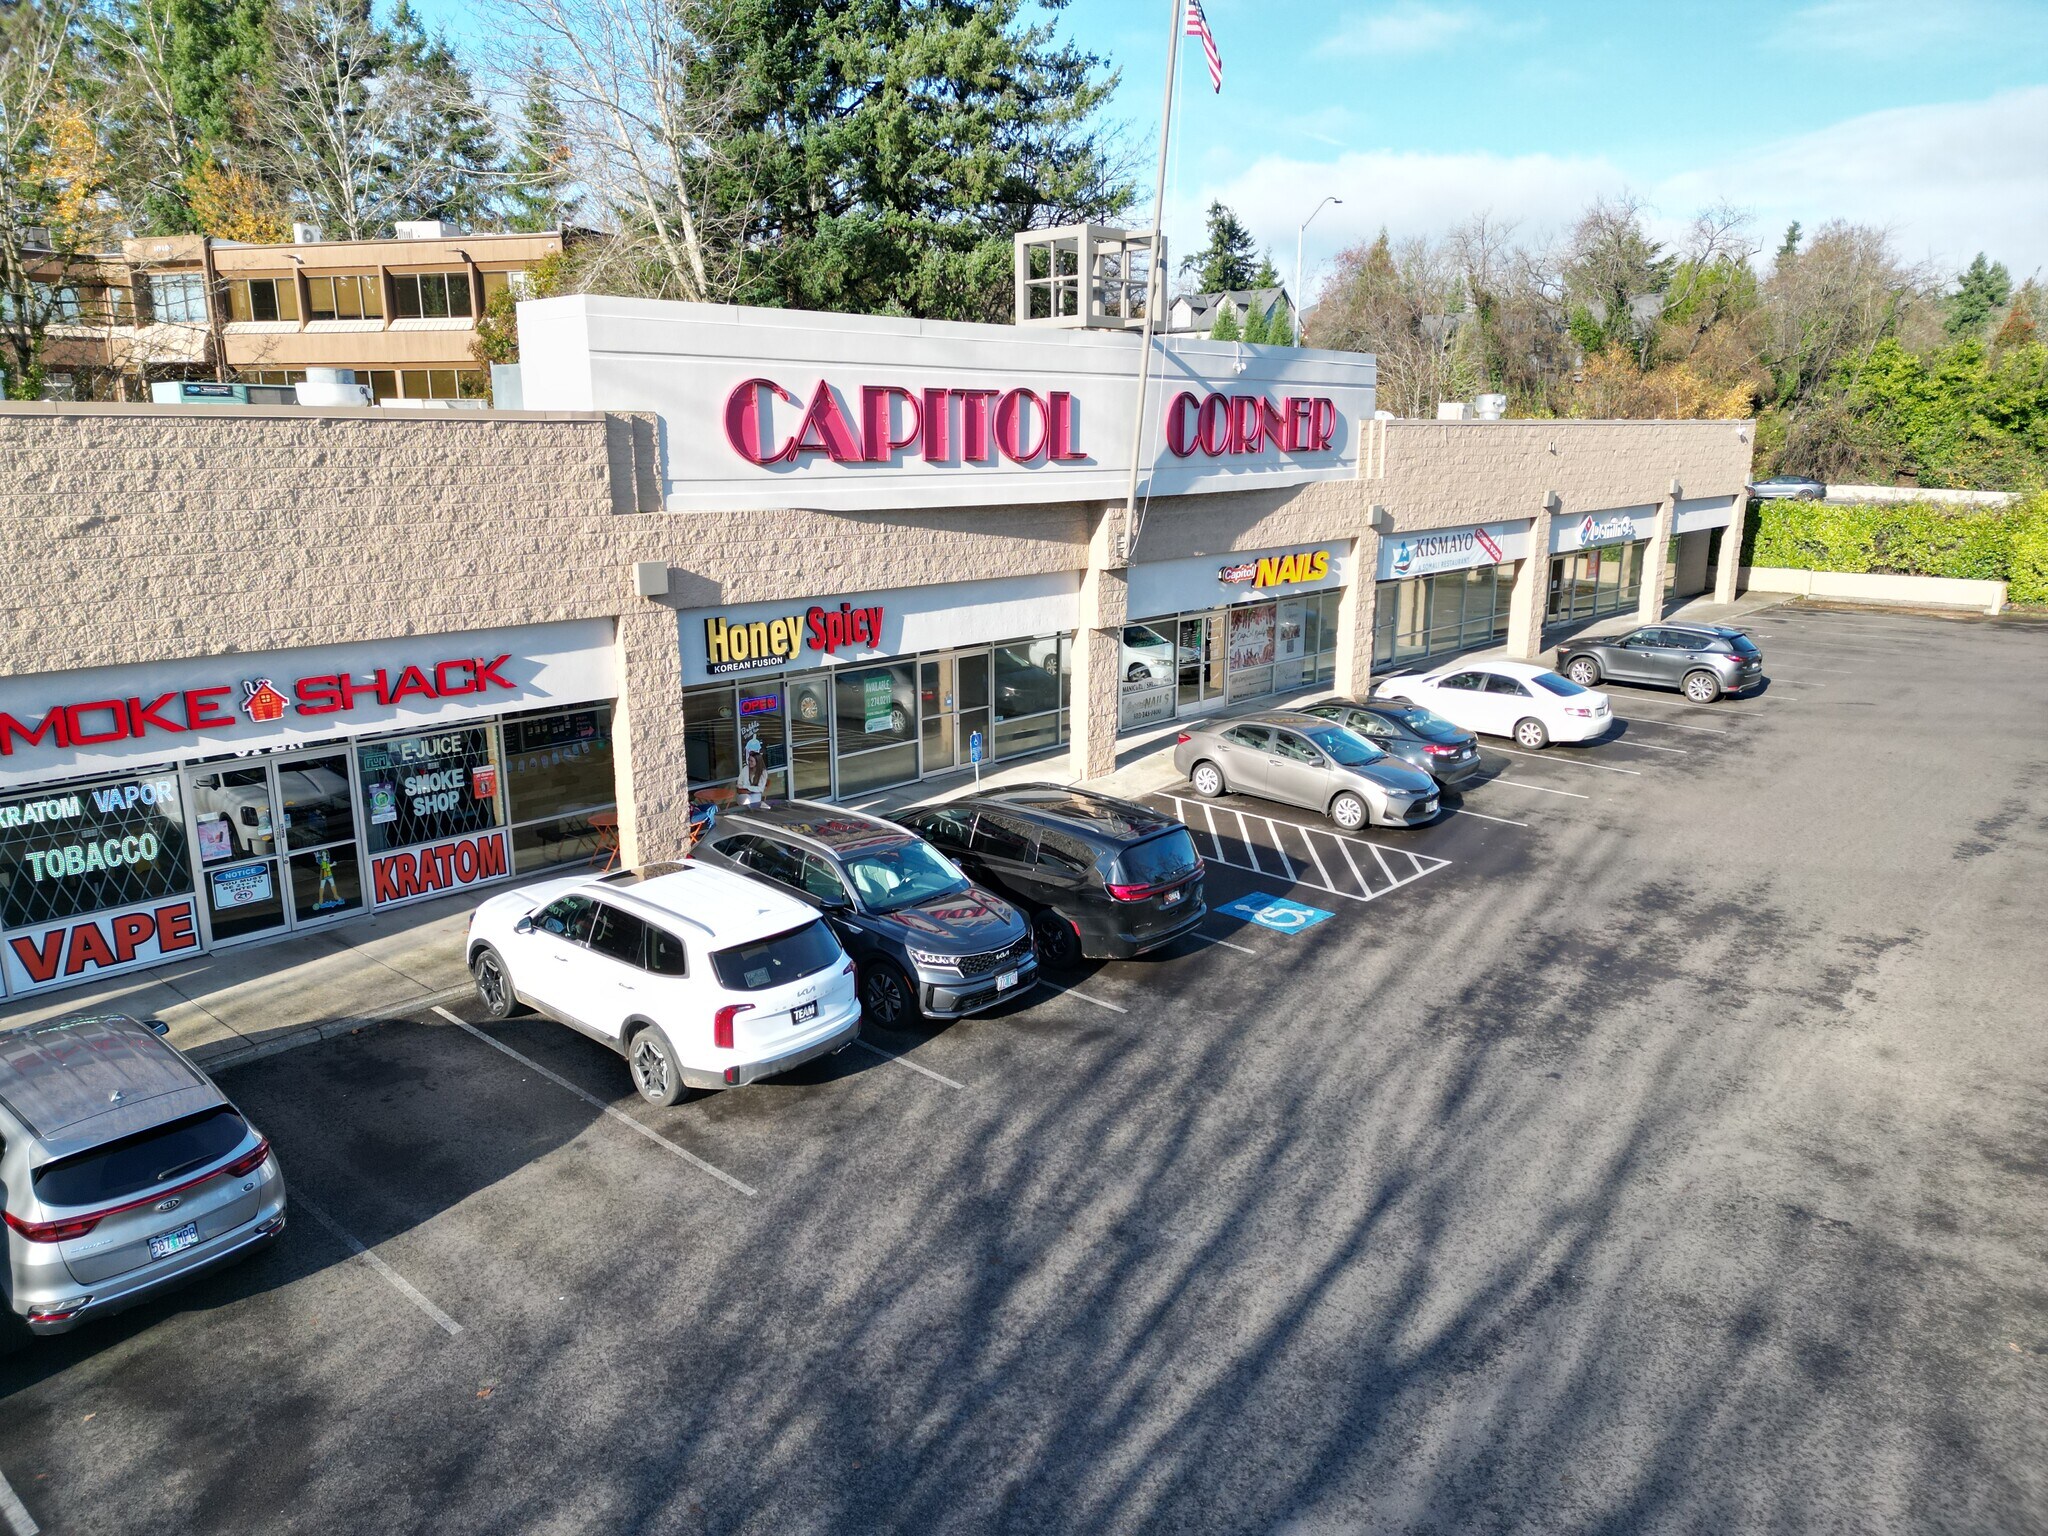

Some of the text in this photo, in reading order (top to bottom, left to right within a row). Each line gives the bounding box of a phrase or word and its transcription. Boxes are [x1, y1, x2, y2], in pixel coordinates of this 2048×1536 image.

[723, 378, 1335, 466] CAPITOL CORNER
[1416, 533, 1474, 557] KISMAYO
[1224, 550, 1330, 589] Capitol NAILS
[705, 603, 885, 664] Honey Spicy
[714, 656, 784, 673] KOREAN FUSION
[294, 653, 517, 715] SHACK
[866, 680, 891, 692] AVAILABLE
[741, 697, 777, 712] OPEN
[401, 735, 463, 761] E-JUICE
[404, 768, 465, 797] SMOKE
[92, 781, 174, 813] VAPOR
[413, 790, 460, 817] SHOP
[25, 832, 158, 881] TOBACCO
[373, 833, 507, 904] KRATOM
[224, 867, 257, 879] NOTICE
[8, 902, 197, 983] VAPE
[794, 1004, 816, 1020] TEAM
[161, 1200, 177, 1210] KIA
[151, 1237, 170, 1255] 587
